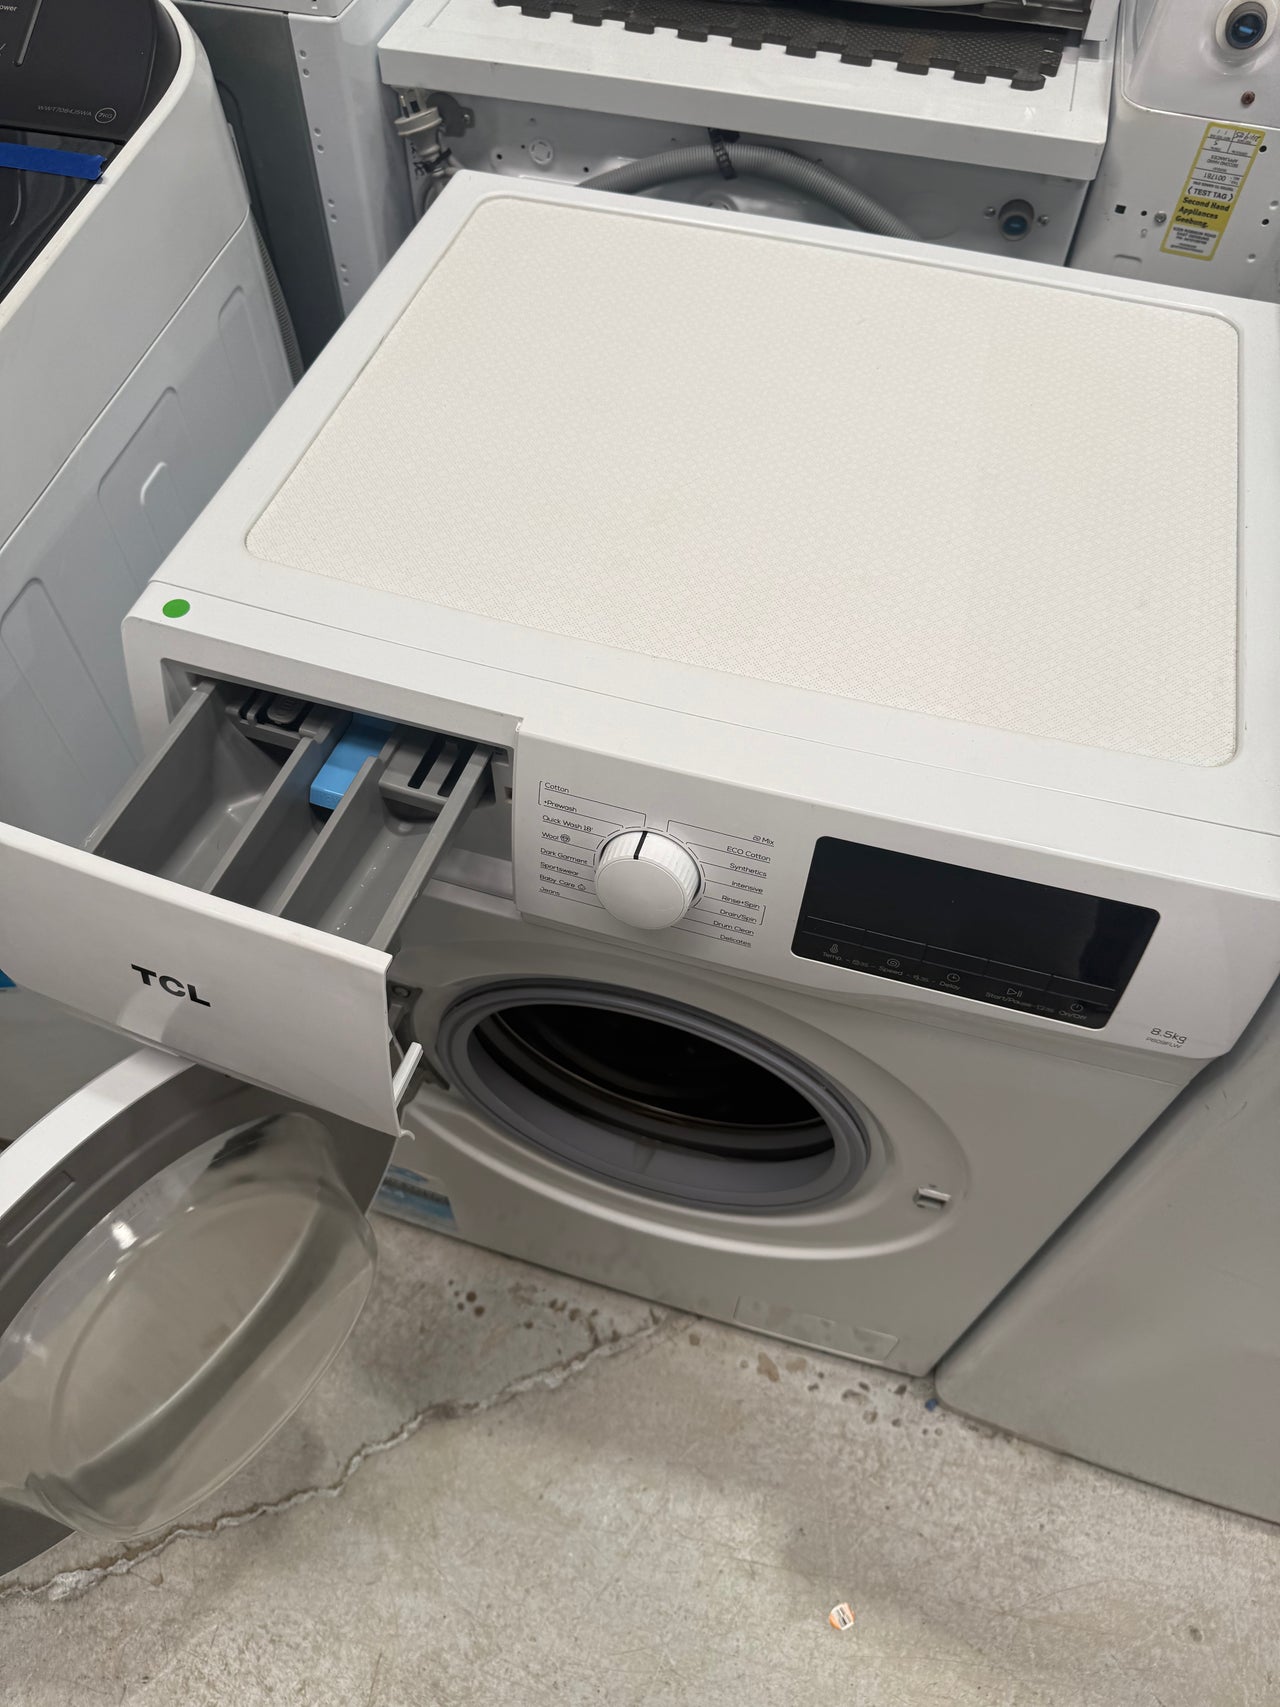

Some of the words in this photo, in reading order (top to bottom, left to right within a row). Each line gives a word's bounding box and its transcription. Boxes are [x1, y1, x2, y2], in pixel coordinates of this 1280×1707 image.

[0, 4, 17, 12] ower
[1193, 187, 1211, 197] TEST
[1213, 191, 1228, 200] TAG
[1182, 196, 1210, 208] Second
[1210, 202, 1230, 212] Hand
[1178, 206, 1218, 220] Appliances
[544, 782, 569, 793] Cotton
[543, 800, 577, 813] +Prewash
[542, 815, 561, 824] Quick
[562, 820, 583, 831] Wash
[541, 832, 559, 840] Wool
[761, 836, 775, 846] Mix
[540, 847, 556, 856] Dark
[557, 853, 588, 864] Garment
[726, 845, 744, 855] ECO
[745, 850, 771, 862] Cotton
[540, 861, 579, 876] Sportswear
[729, 862, 767, 877] Synthetics
[539, 873, 557, 884] Baby
[558, 880, 576, 888] Care
[731, 880, 764, 893] Intensive
[539, 886, 560, 896] Jeans
[721, 894, 760, 910] Rinse+Spin
[719, 908, 757, 923] Drain/Spin
[713, 920, 733, 930] Drum
[734, 925, 755, 935] Clean
[720, 934, 752, 948] Delicates
[879, 965, 903, 976] Speed
[131, 964, 211, 1007] TCL
[939, 981, 961, 991] Delay
[1058, 1009, 1087, 1021] On/Off
[1150, 1026, 1188, 1044] 8.5kg
